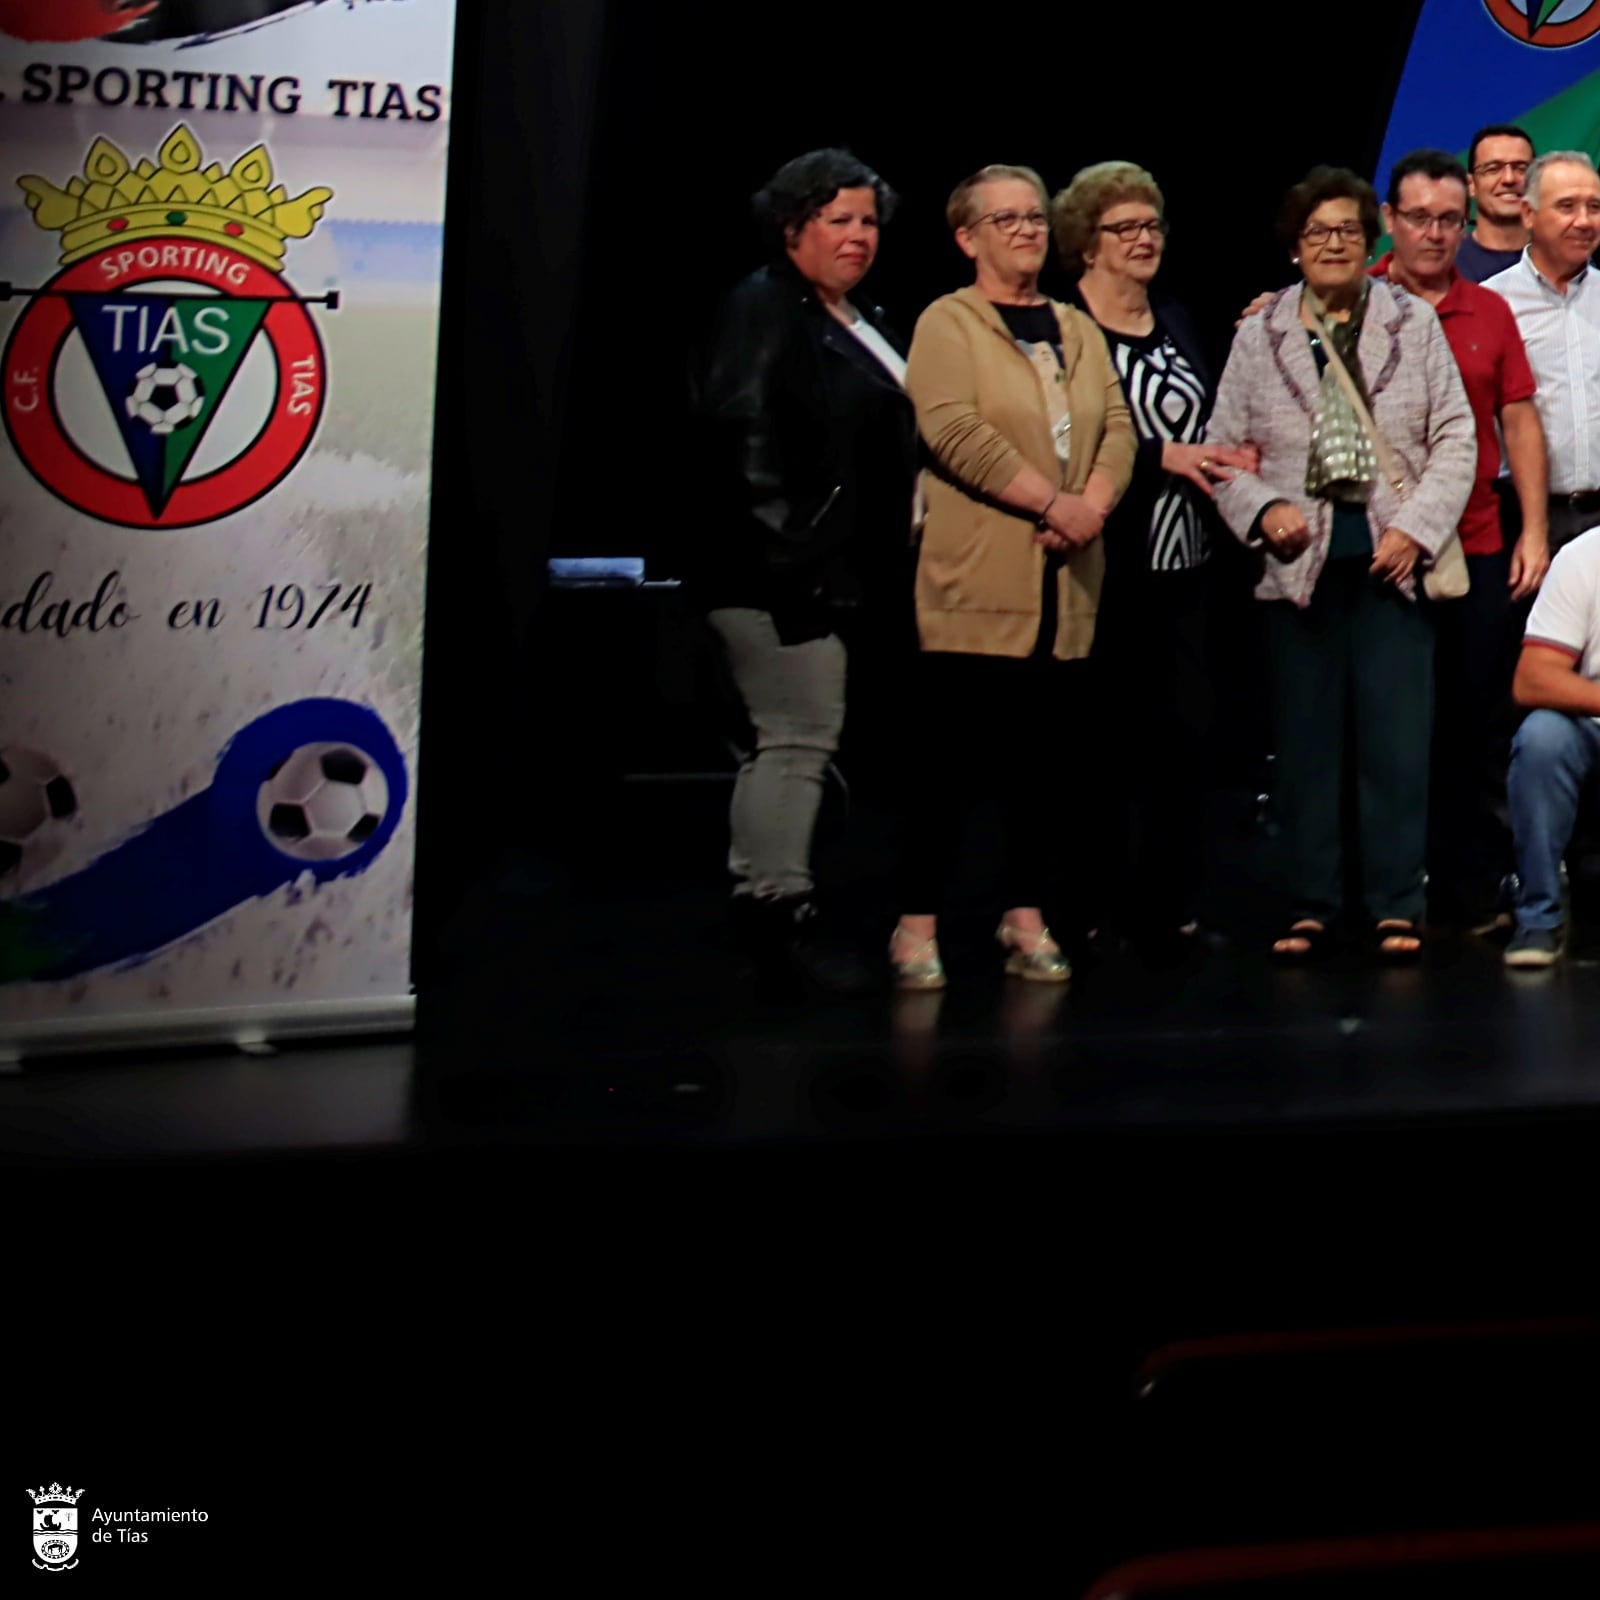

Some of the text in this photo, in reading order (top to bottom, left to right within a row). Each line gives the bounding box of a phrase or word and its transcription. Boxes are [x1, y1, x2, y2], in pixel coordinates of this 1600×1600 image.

[22, 62, 443, 121] SPORTING TIAS
[100, 245, 251, 286] SPORTING
[101, 304, 231, 355] TIAS
[287, 354, 316, 416] TIAS
[168, 592, 224, 631] en
[252, 582, 373, 631] 1974
